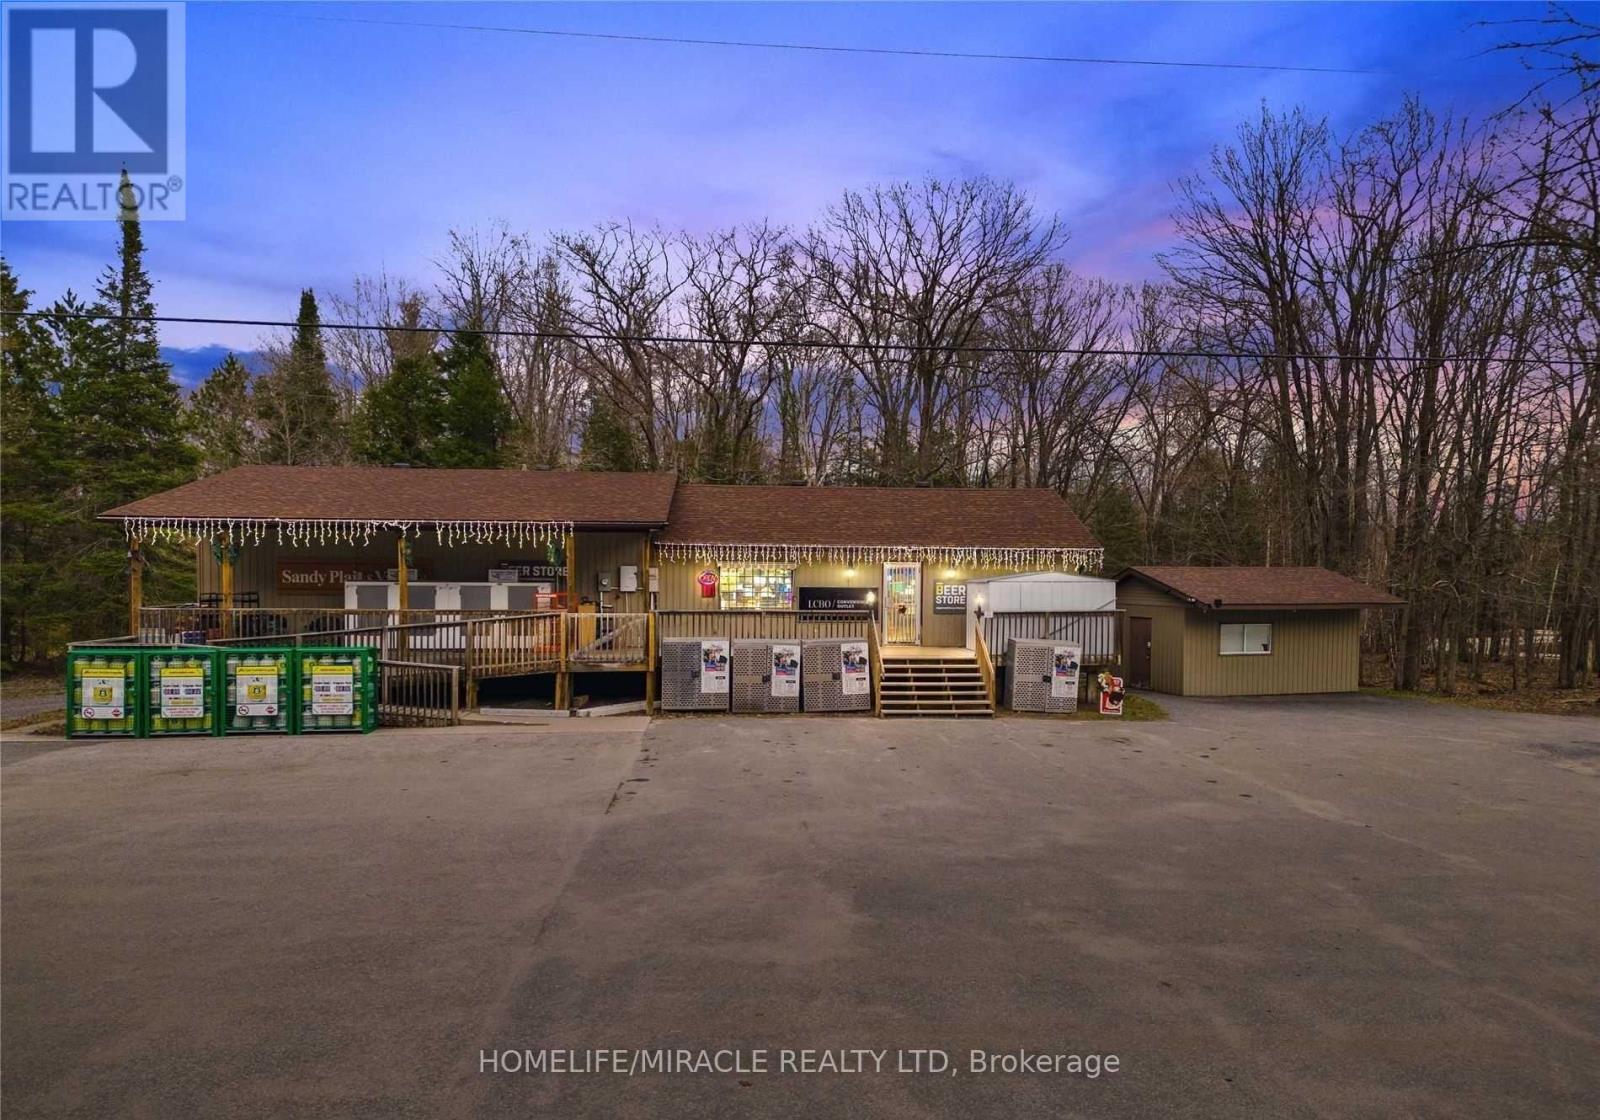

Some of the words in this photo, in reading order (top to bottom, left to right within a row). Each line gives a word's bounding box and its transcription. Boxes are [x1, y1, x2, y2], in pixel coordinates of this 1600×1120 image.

[282, 569, 326, 586] Sandy
[936, 582, 966, 596] BEER
[808, 600, 831, 609] LCBO
[935, 596, 966, 605] STORE
